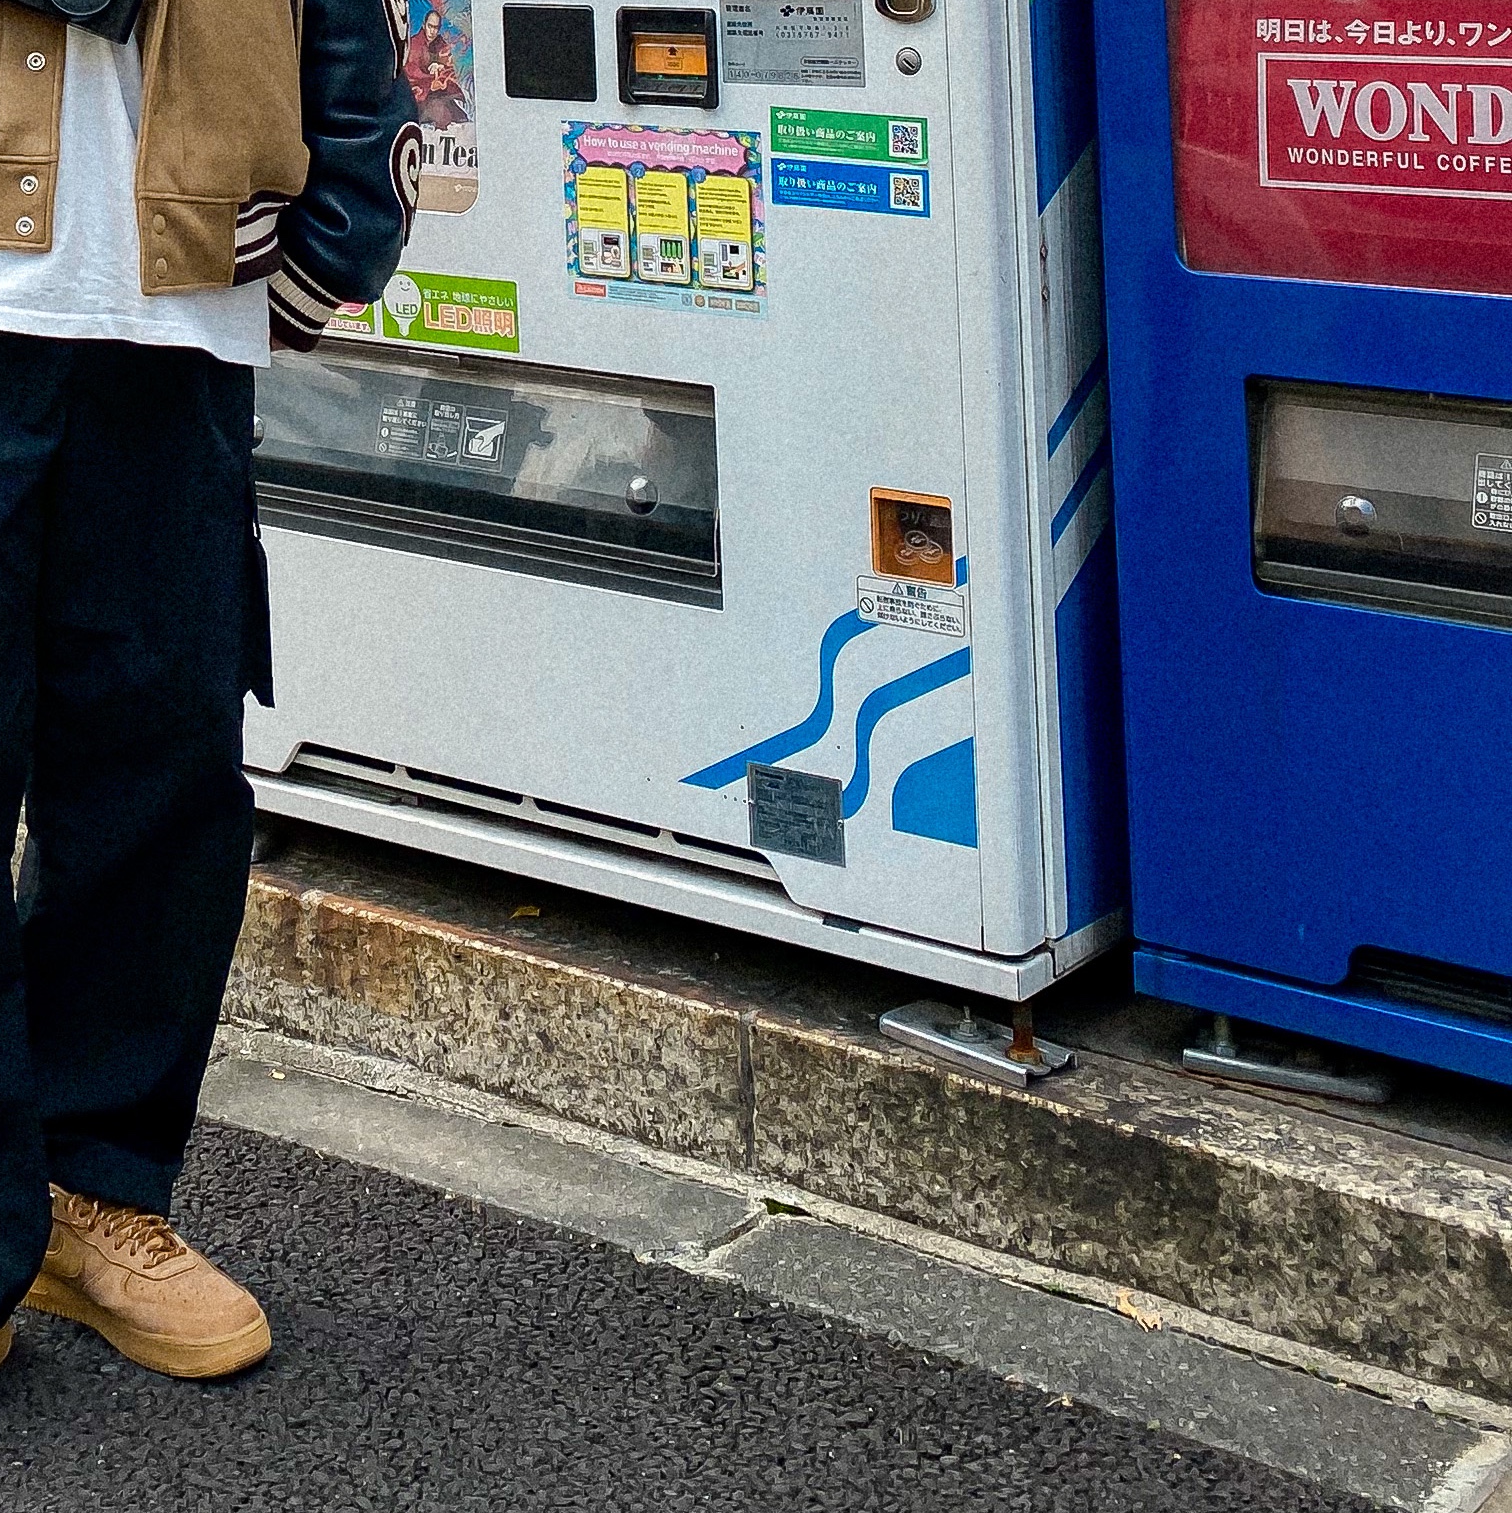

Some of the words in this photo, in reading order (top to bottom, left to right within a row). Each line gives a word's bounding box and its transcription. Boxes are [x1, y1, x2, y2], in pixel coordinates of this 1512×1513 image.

[440, 137, 477, 169] Tea
[584, 136, 607, 147] How
[608, 139, 618, 147] to
[619, 141, 638, 149] use
[649, 140, 689, 154] vending
[692, 142, 738, 156] machine
[1288, 147, 1424, 170] WONDERFUL
[778, 175, 877, 195] 取り扱い商品のご案内
[423, 289, 449, 301] 省エネ
[452, 291, 513, 307] 地球にやさしい
[396, 303, 417, 315] LED
[424, 302, 515, 337] LED照明
